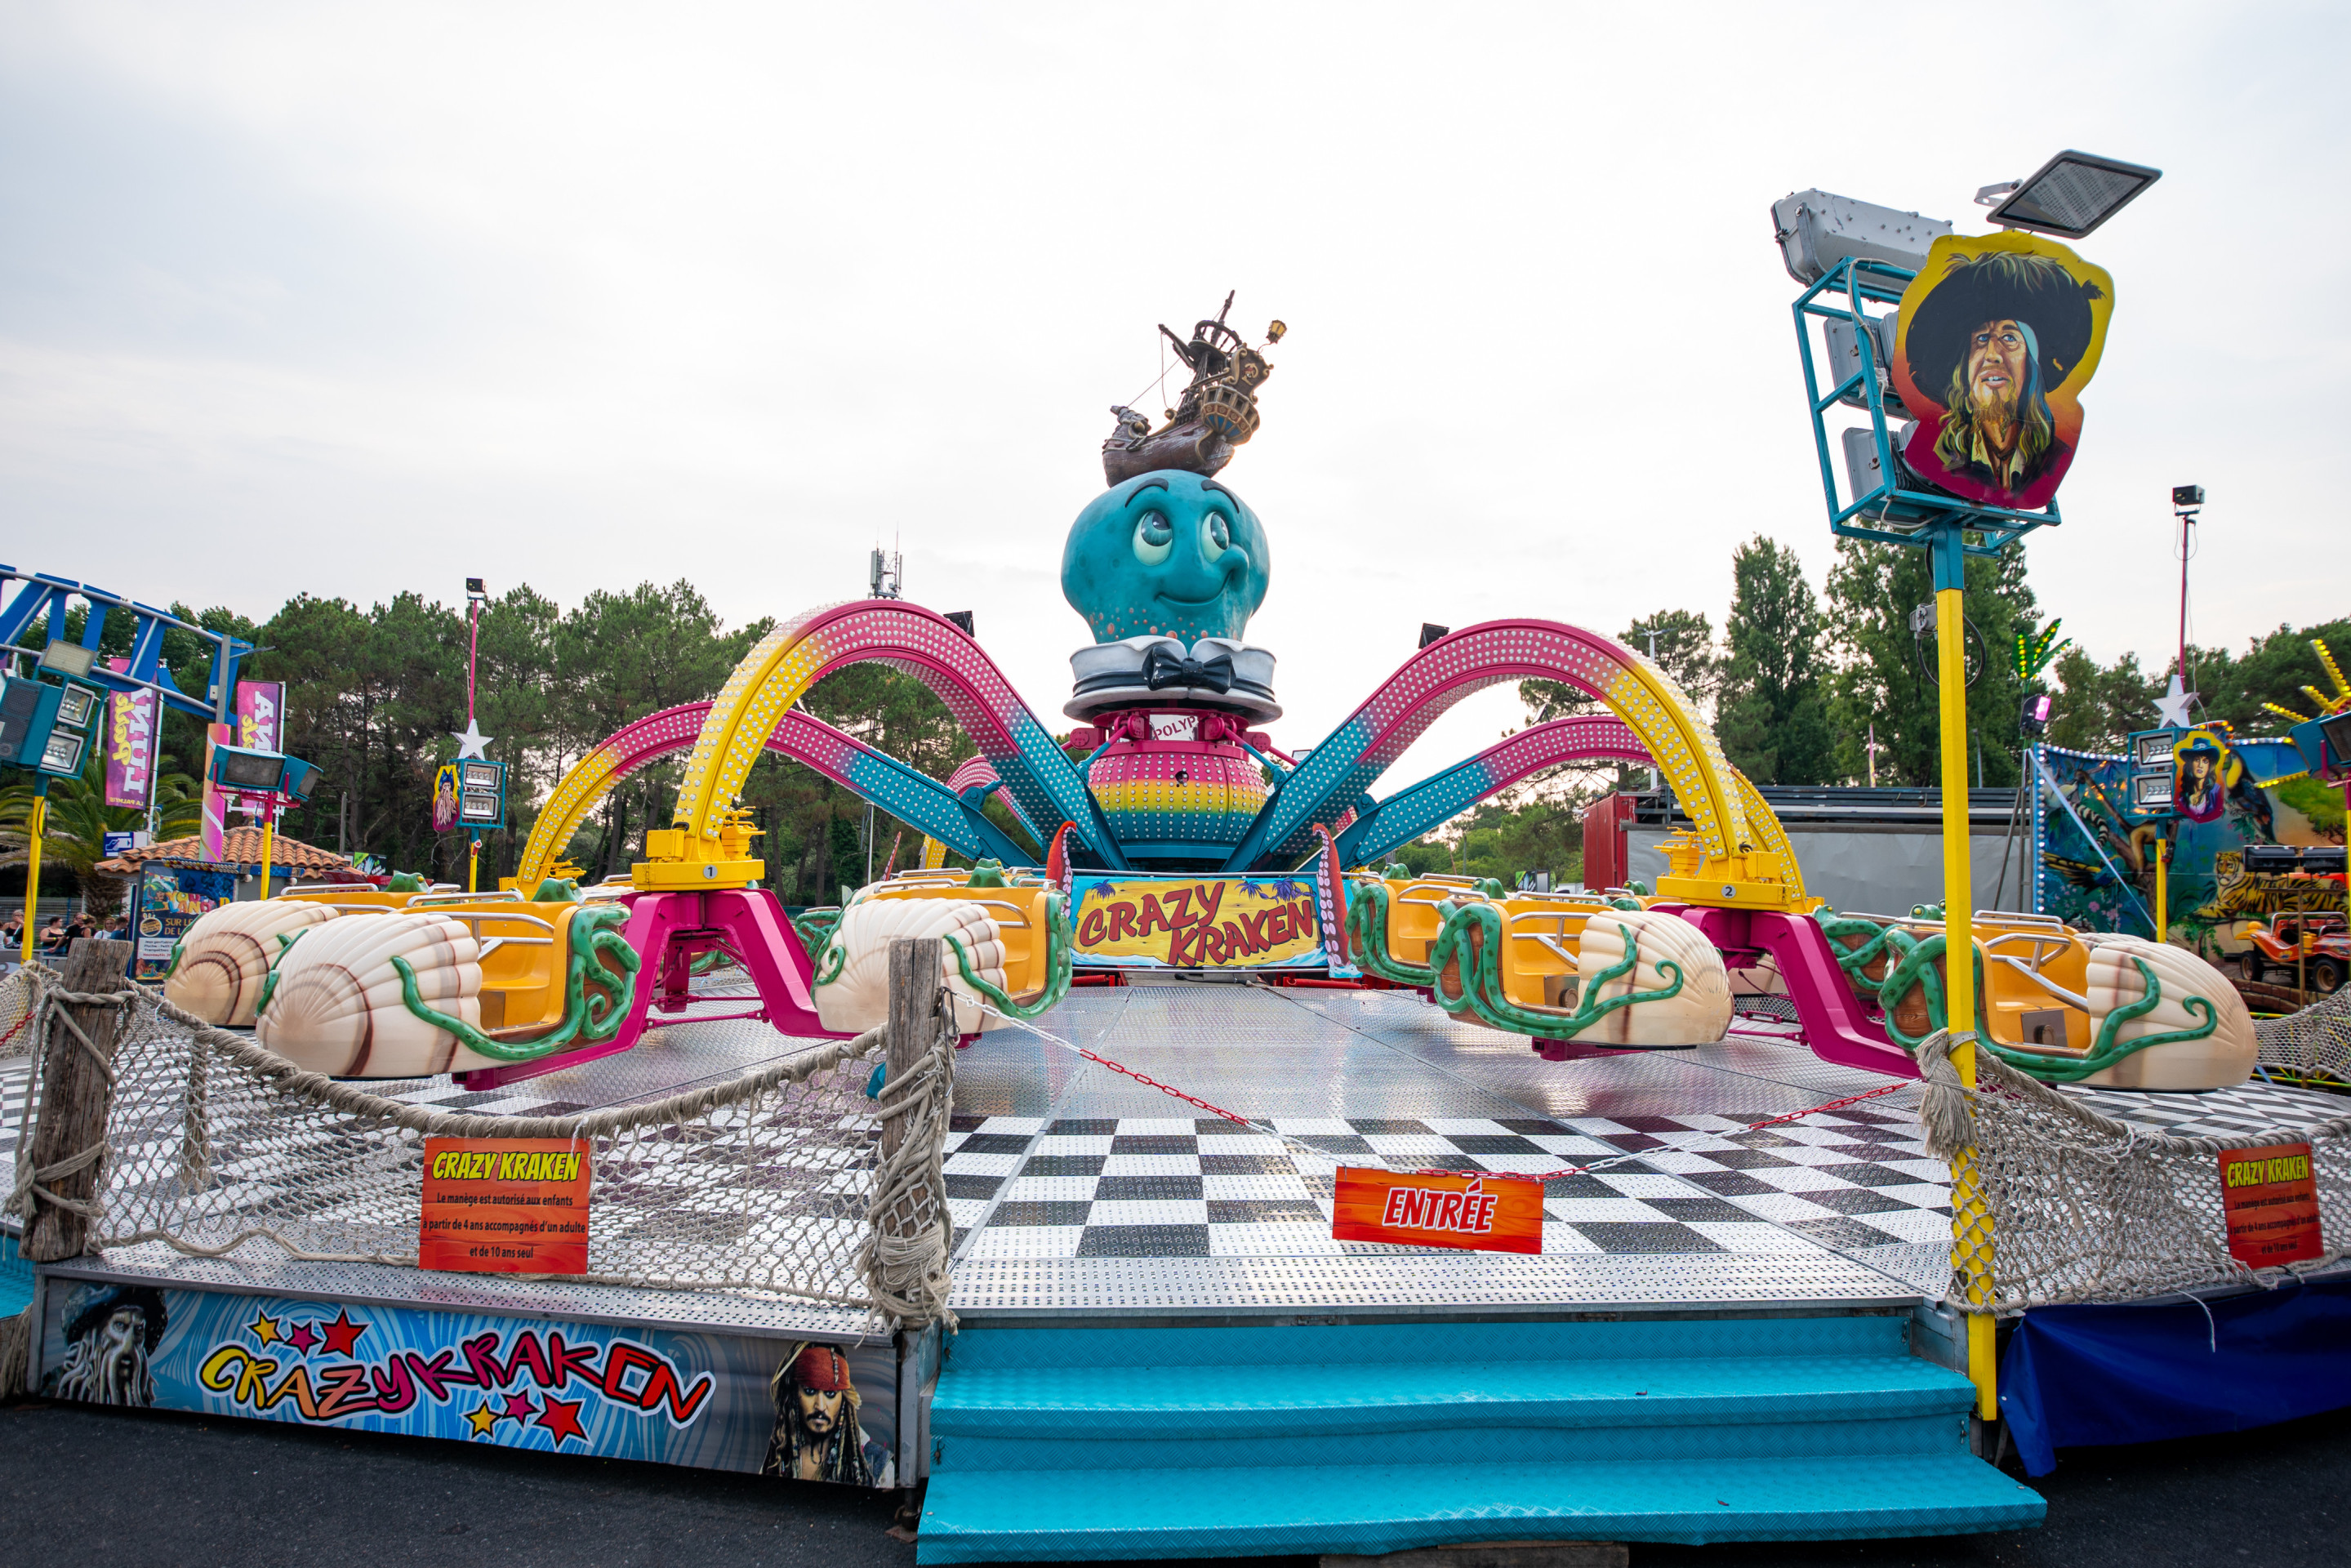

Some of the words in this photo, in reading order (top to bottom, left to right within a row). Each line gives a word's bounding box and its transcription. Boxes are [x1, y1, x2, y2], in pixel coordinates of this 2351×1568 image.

[1153, 715, 1196, 741] POLYP
[707, 866, 713, 877] 1
[1725, 886, 1733, 897] 2
[168, 900, 211, 914] LAND
[1079, 881, 1226, 947] CRAZY
[165, 918, 182, 926] SUR
[164, 927, 176, 935] DE
[1168, 899, 1314, 966] KRAKEN
[432, 1151, 499, 1180] CRAZY
[497, 1151, 582, 1183] KRAKEN
[2227, 1160, 2265, 1188] CRAZY
[2267, 1154, 2309, 1184] KRAKEN
[437, 1192, 446, 1204] Le
[447, 1195, 477, 1206] manège
[479, 1196, 492, 1204] est
[492, 1193, 525, 1205] autorisé
[527, 1197, 541, 1205] aux
[542, 1194, 573, 1206] enfants
[1382, 1177, 1498, 1233] ENTRÉE
[423, 1220, 427, 1229] à
[429, 1218, 451, 1232] partir
[452, 1219, 462, 1230] de
[463, 1219, 468, 1230] 4
[470, 1222, 483, 1231] ans
[485, 1222, 538, 1234] accompagnés
[559, 1221, 586, 1233] adulte
[470, 1247, 477, 1257] et
[479, 1245, 489, 1257] de
[491, 1246, 500, 1257] 10
[501, 1249, 515, 1258] ans
[517, 1247, 534, 1258] seul
